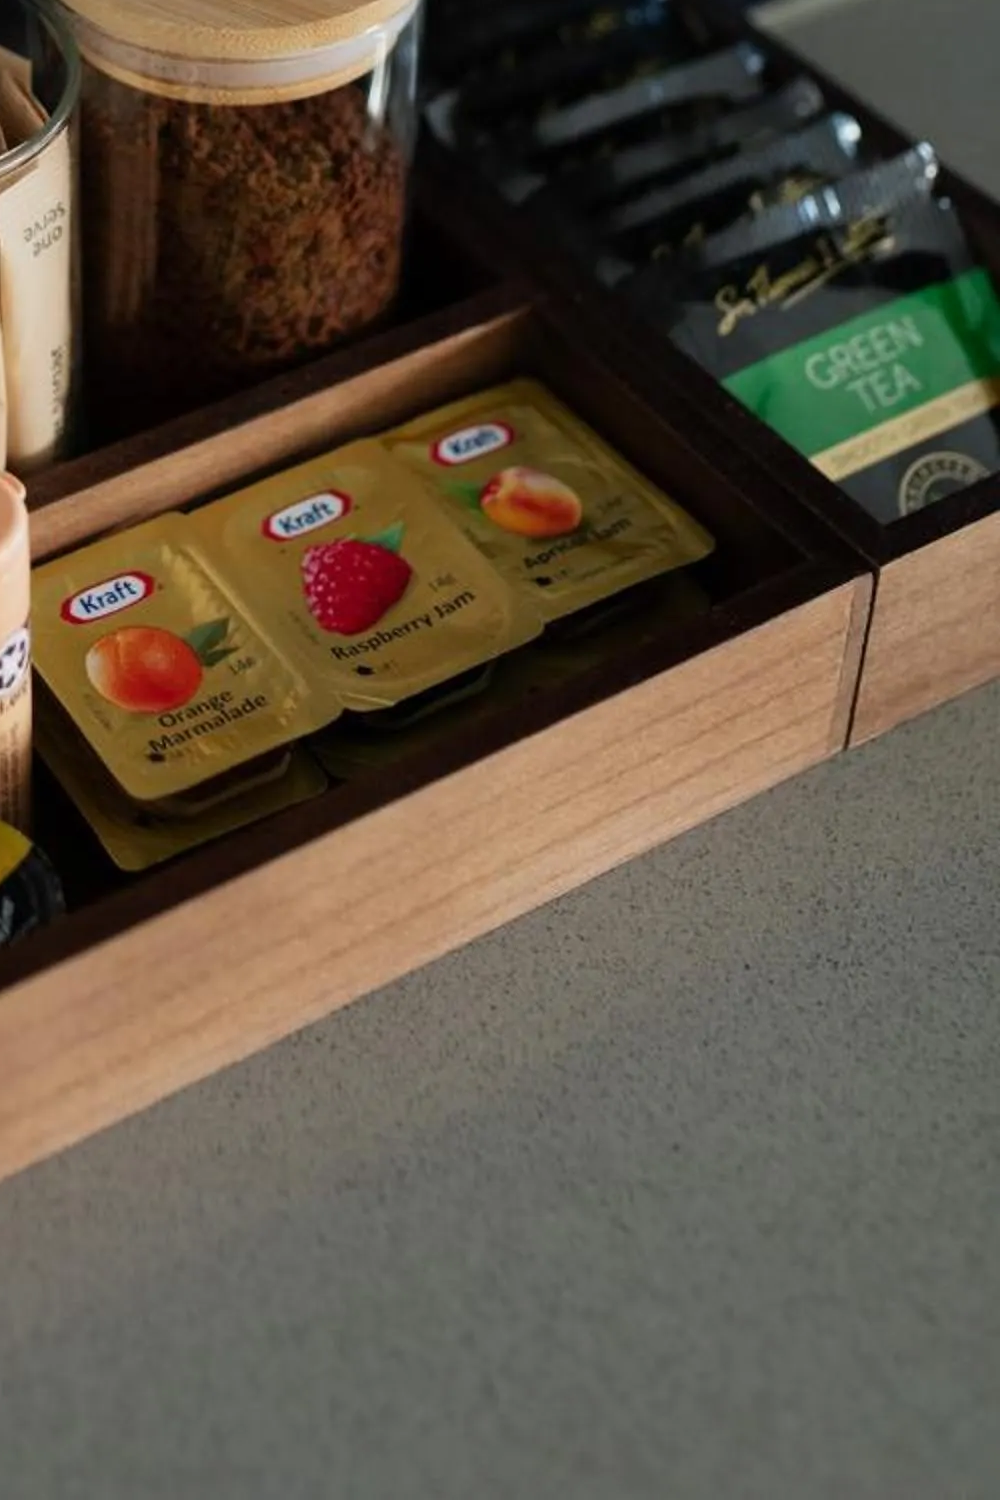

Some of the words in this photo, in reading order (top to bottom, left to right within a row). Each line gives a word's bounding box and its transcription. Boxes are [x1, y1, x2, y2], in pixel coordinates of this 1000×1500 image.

[804, 315, 925, 390] GREEN
[846, 363, 923, 415] TEA
[278, 501, 335, 534] Kraft
[79, 580, 138, 614] Kraft
[330, 612, 434, 661] Raspberry
[433, 589, 477, 620] Jam
[148, 693, 269, 754] Marmalade
[158, 690, 233, 729] Orange
